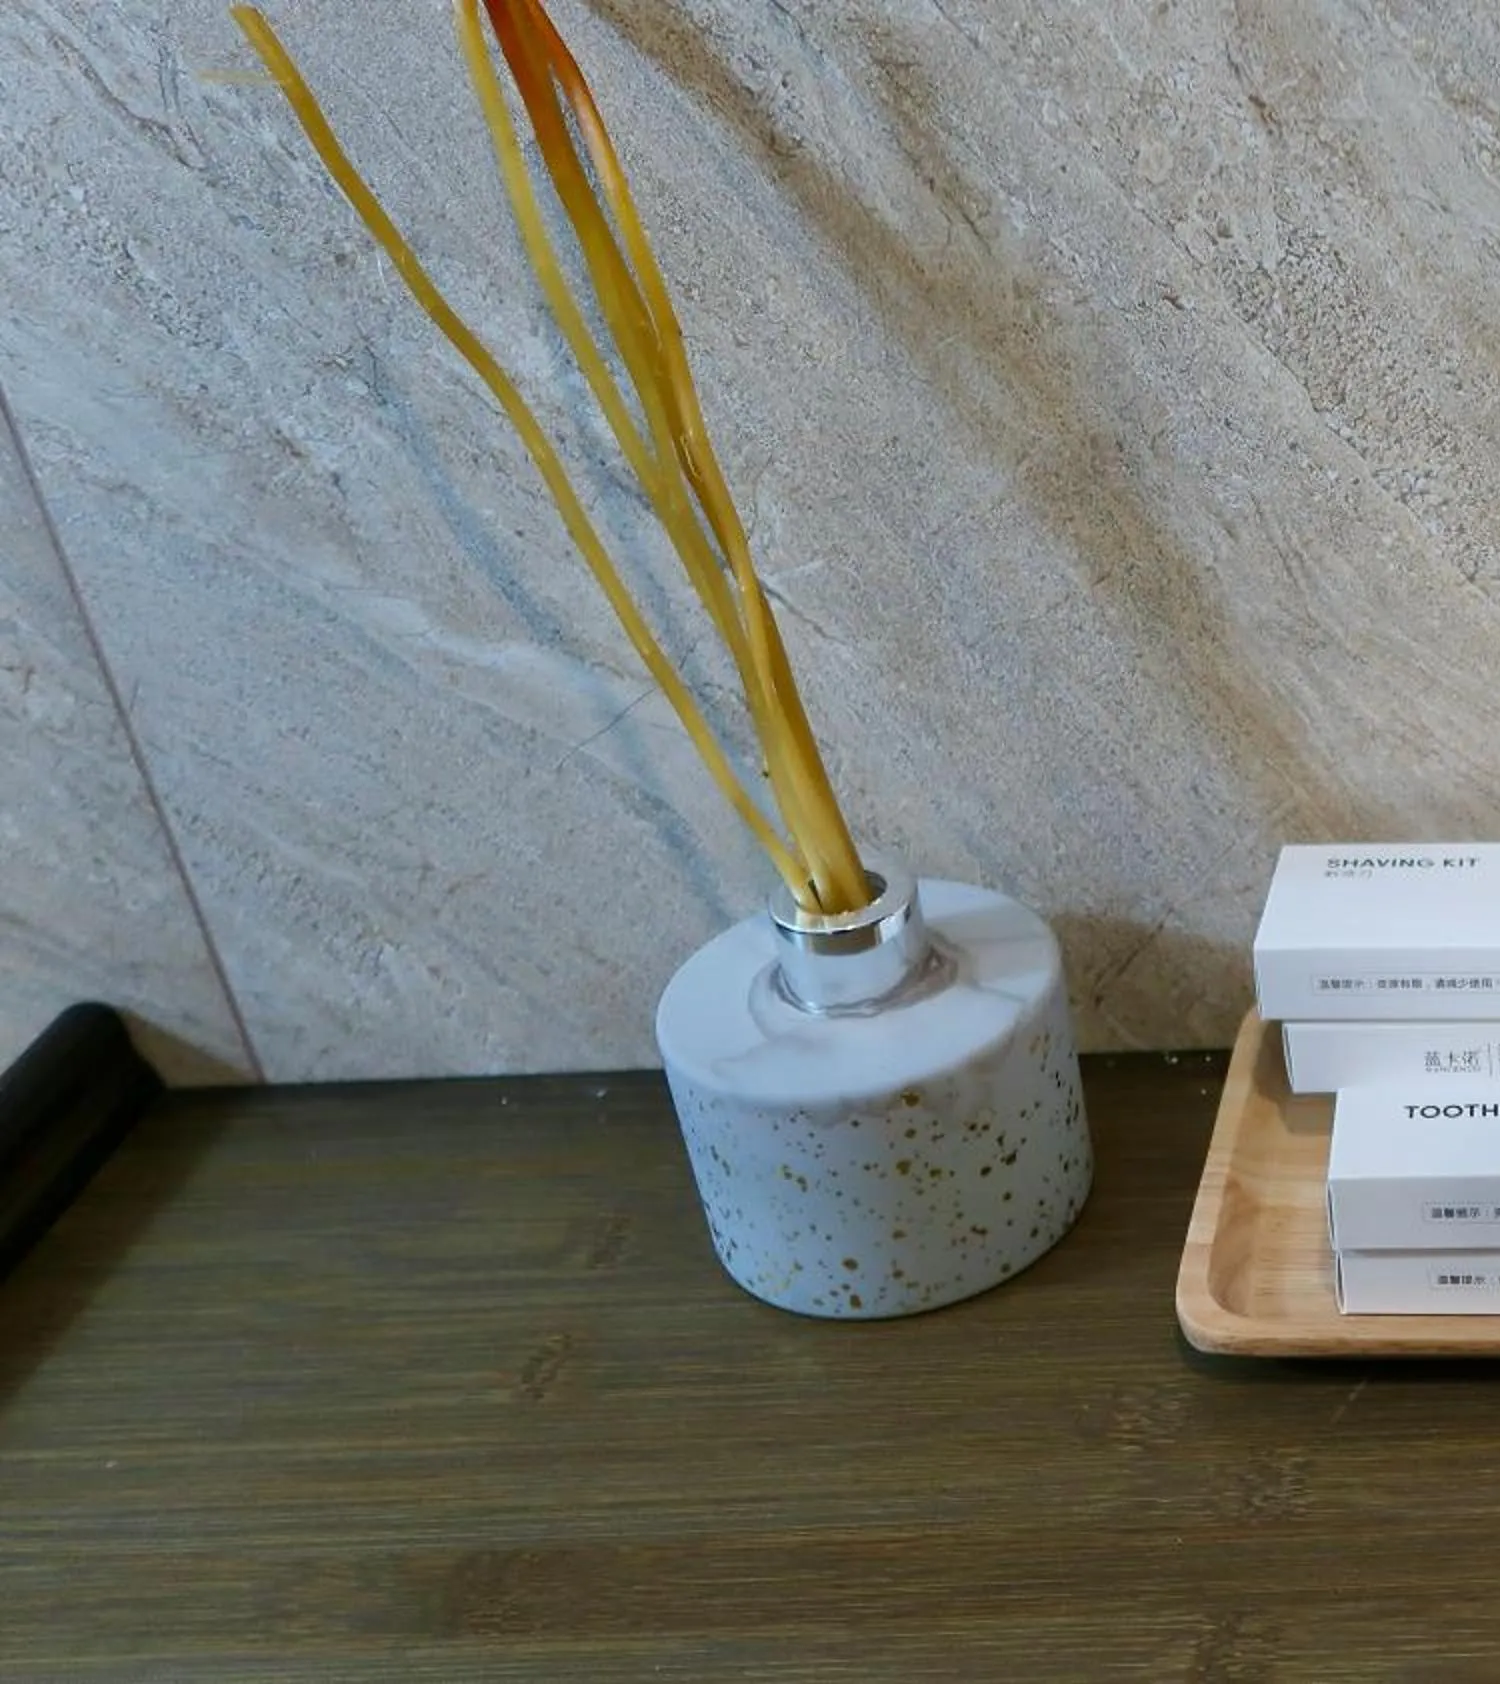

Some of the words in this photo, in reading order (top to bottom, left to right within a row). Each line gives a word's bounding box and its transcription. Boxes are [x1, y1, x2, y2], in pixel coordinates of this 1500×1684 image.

[1327, 857, 1435, 869] SHAVING
[1443, 857, 1480, 868] KIT
[1404, 1103, 1499, 1118] TOOTH
